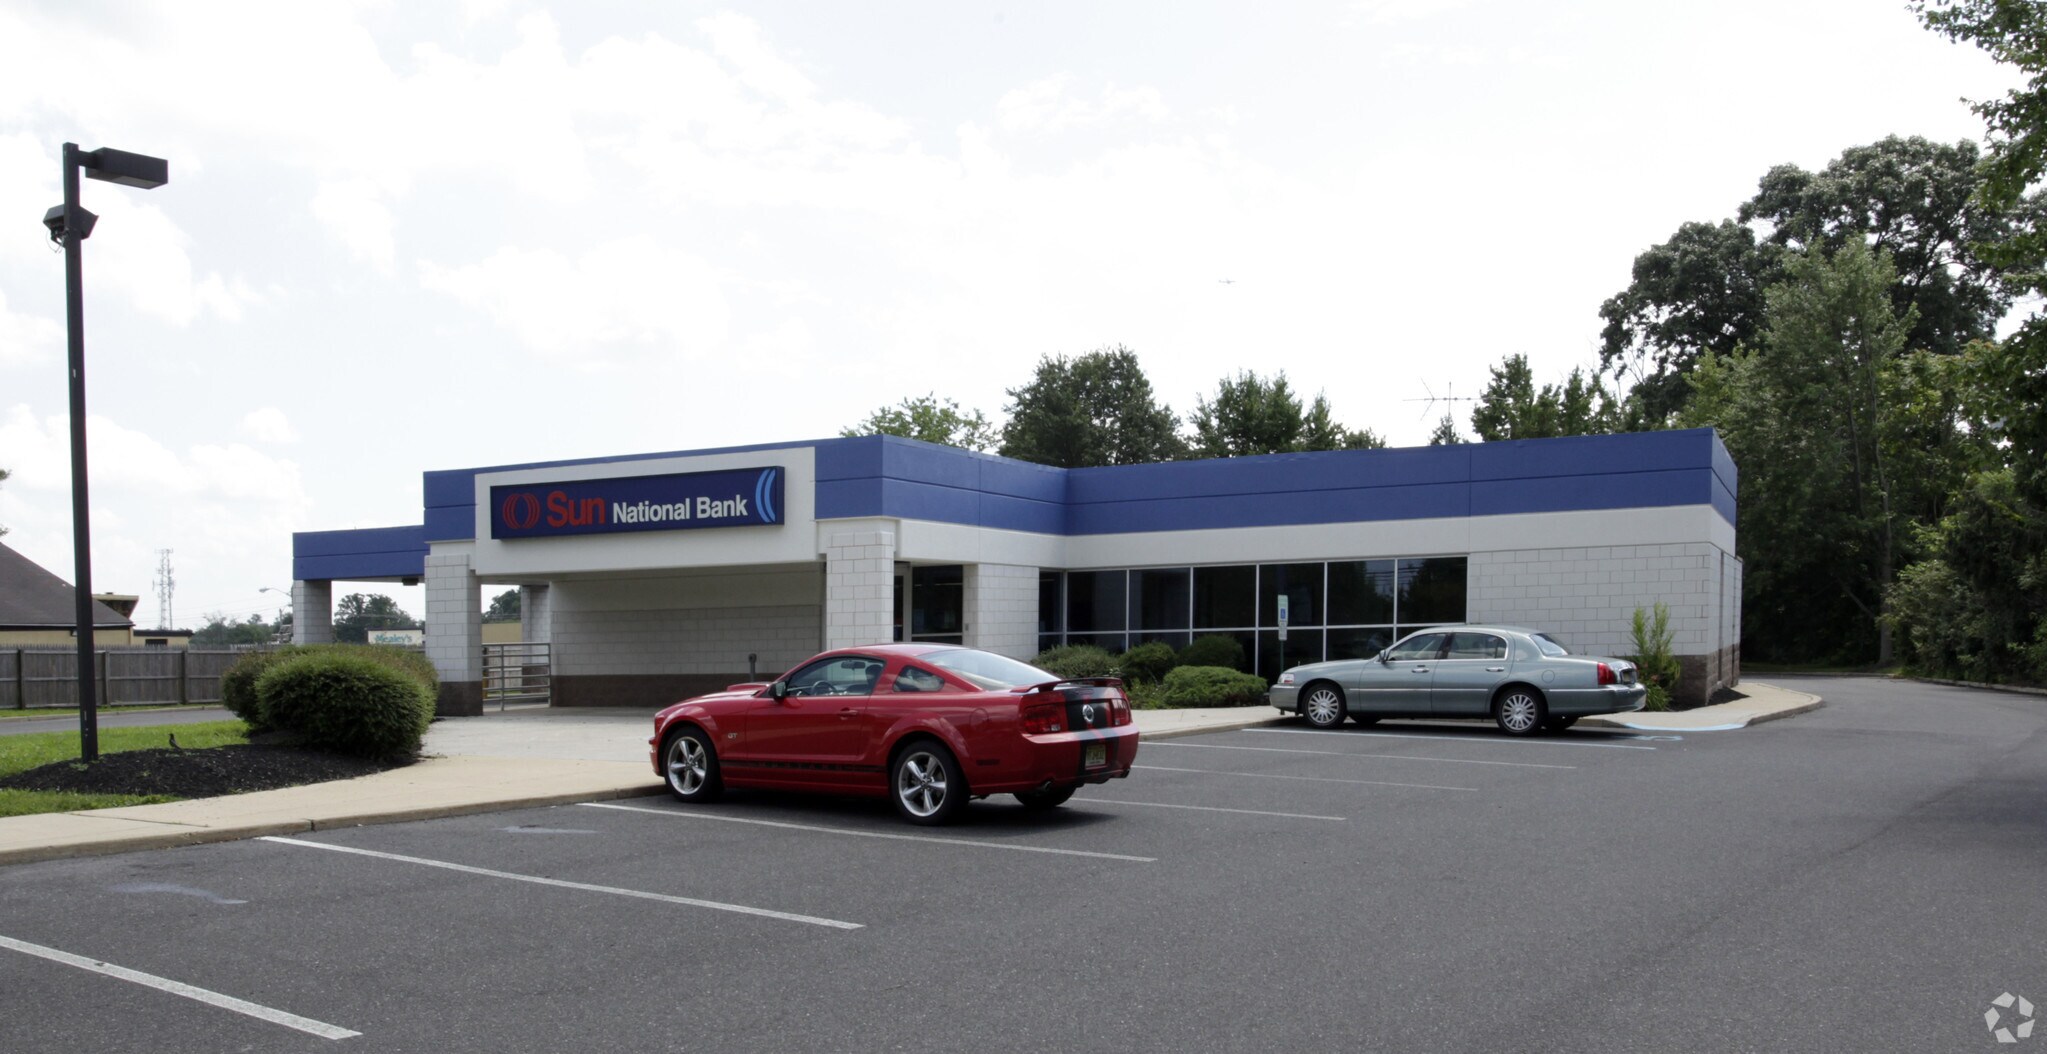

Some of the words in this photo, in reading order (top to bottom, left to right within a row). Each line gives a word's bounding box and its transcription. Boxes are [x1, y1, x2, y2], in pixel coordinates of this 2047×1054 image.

[547, 491, 605, 527] Sun
[613, 497, 690, 524] National
[697, 495, 748, 519] Bank
